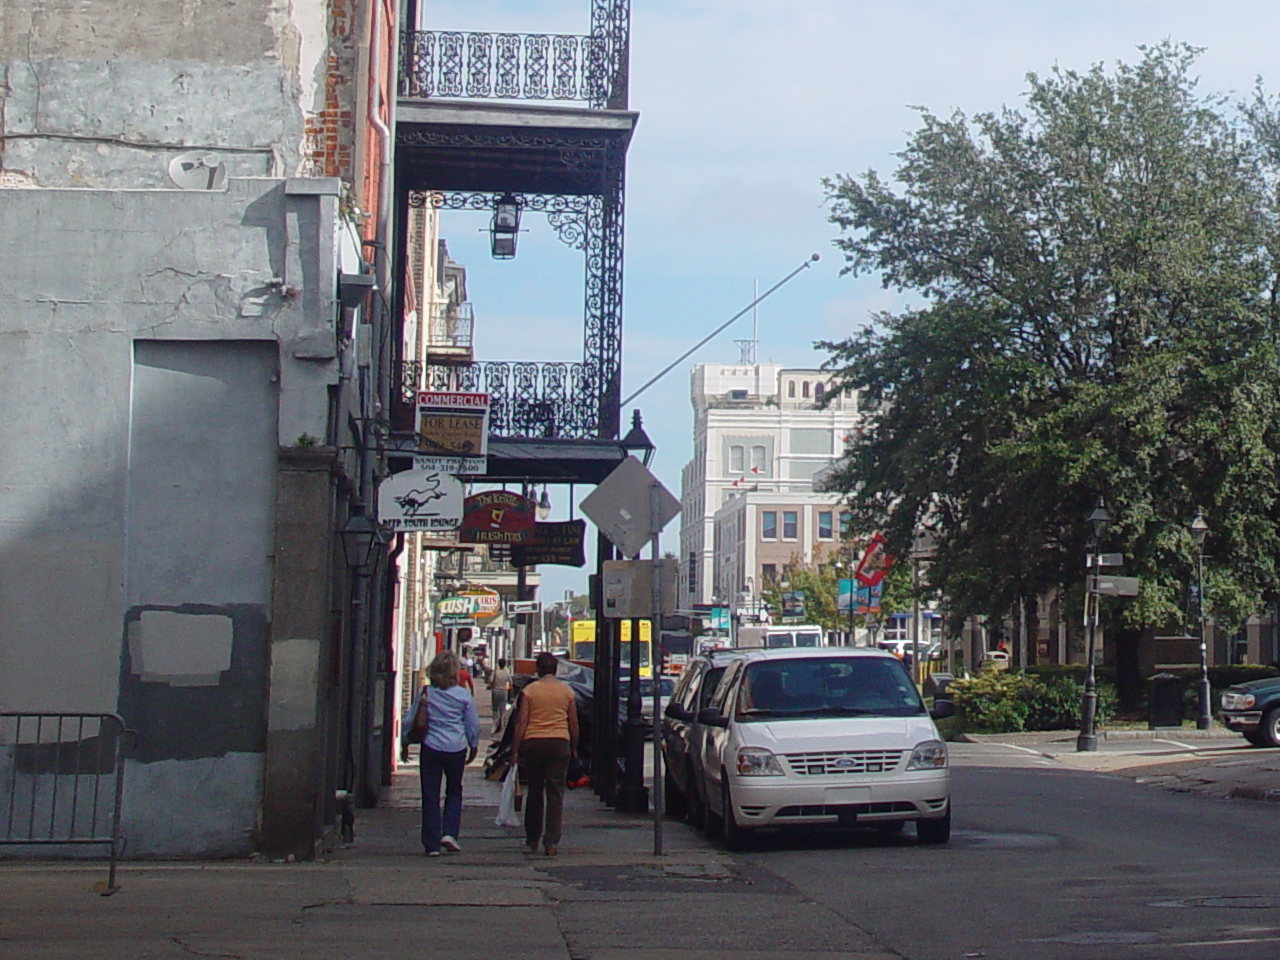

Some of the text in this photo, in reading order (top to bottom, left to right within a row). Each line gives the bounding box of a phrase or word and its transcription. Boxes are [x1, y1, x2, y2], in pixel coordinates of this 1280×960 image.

[419, 393, 487, 407] COMMERCIAL
[423, 417, 481, 430] FOR LEASE
[441, 598, 475, 614] LUSH
